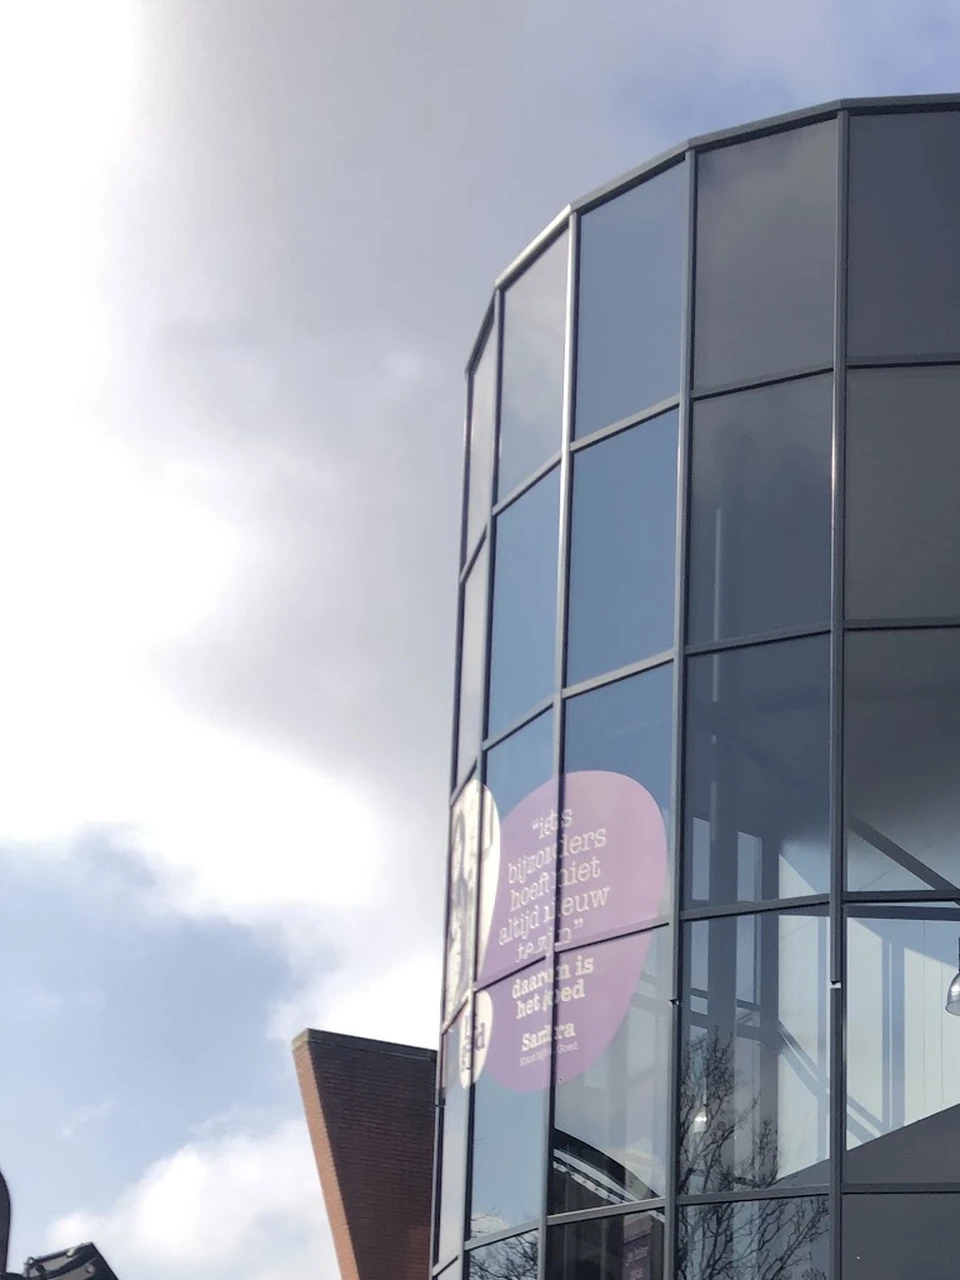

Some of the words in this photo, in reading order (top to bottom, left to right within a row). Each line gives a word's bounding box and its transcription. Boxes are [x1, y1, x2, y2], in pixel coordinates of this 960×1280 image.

[509, 871, 550, 912] hoeft
[499, 905, 540, 946] altijd
[543, 886, 611, 924] neuw
[575, 955, 594, 976] is
[516, 993, 540, 1019] het
